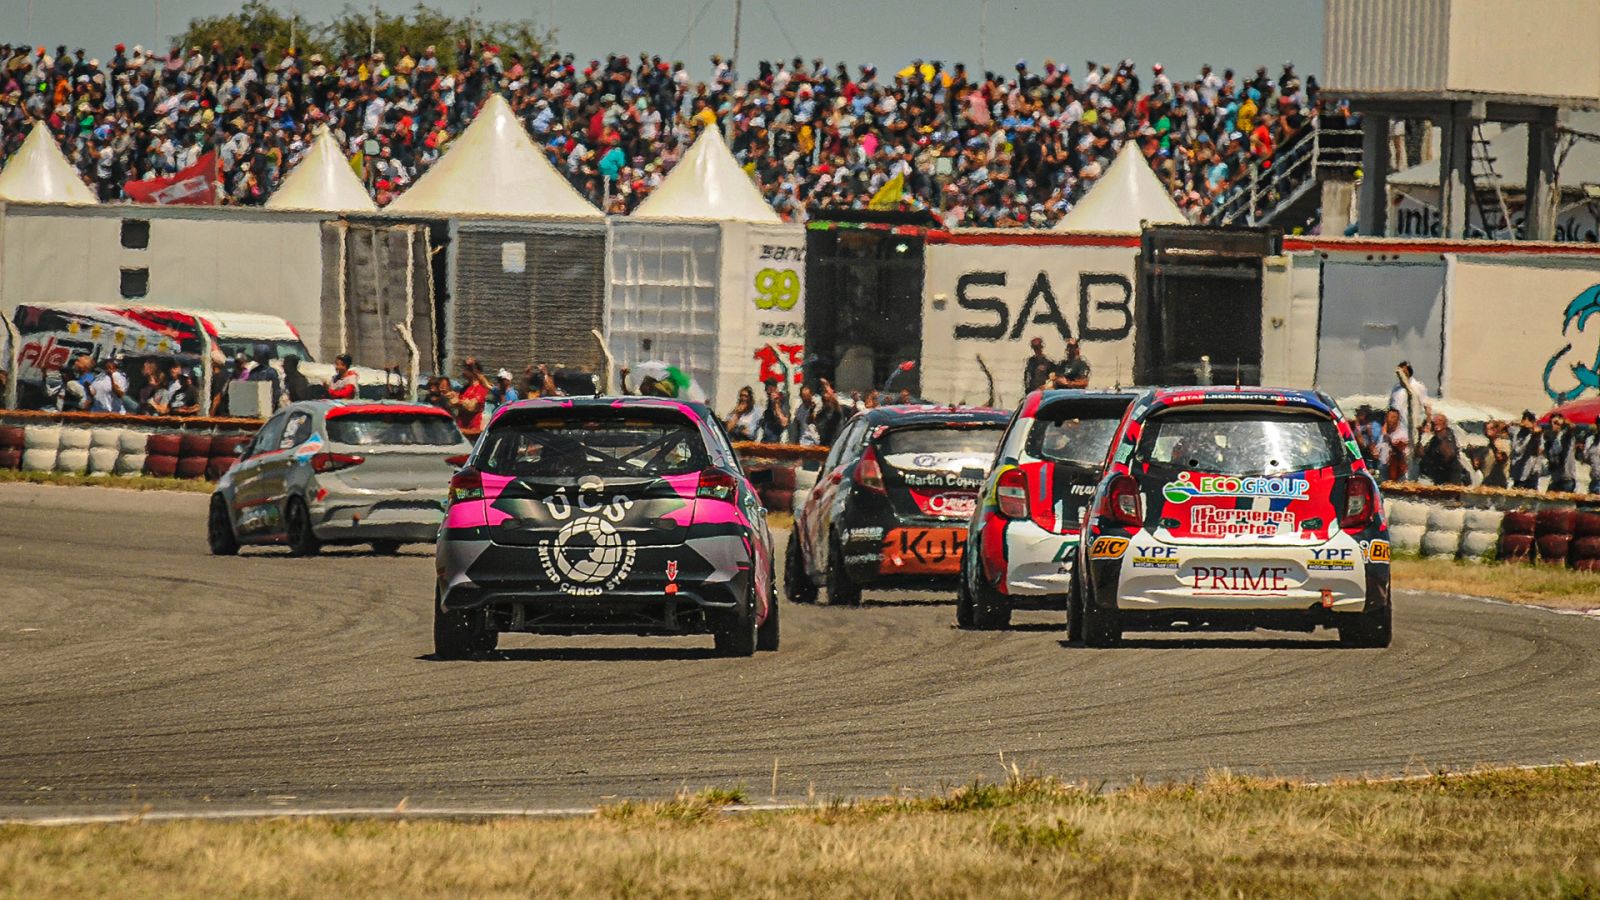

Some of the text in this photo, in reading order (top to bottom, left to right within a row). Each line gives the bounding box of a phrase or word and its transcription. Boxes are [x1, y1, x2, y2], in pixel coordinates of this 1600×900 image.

[754, 268, 800, 311] 99
[954, 271, 1132, 342] SAB
[905, 474, 943, 487] Martin
[1201, 477, 1310, 496] ECOGROUP
[1191, 521, 1277, 539] deportes
[1136, 545, 1178, 558] YPF
[1310, 548, 1353, 560] YPF
[1191, 566, 1288, 591] PRIME
